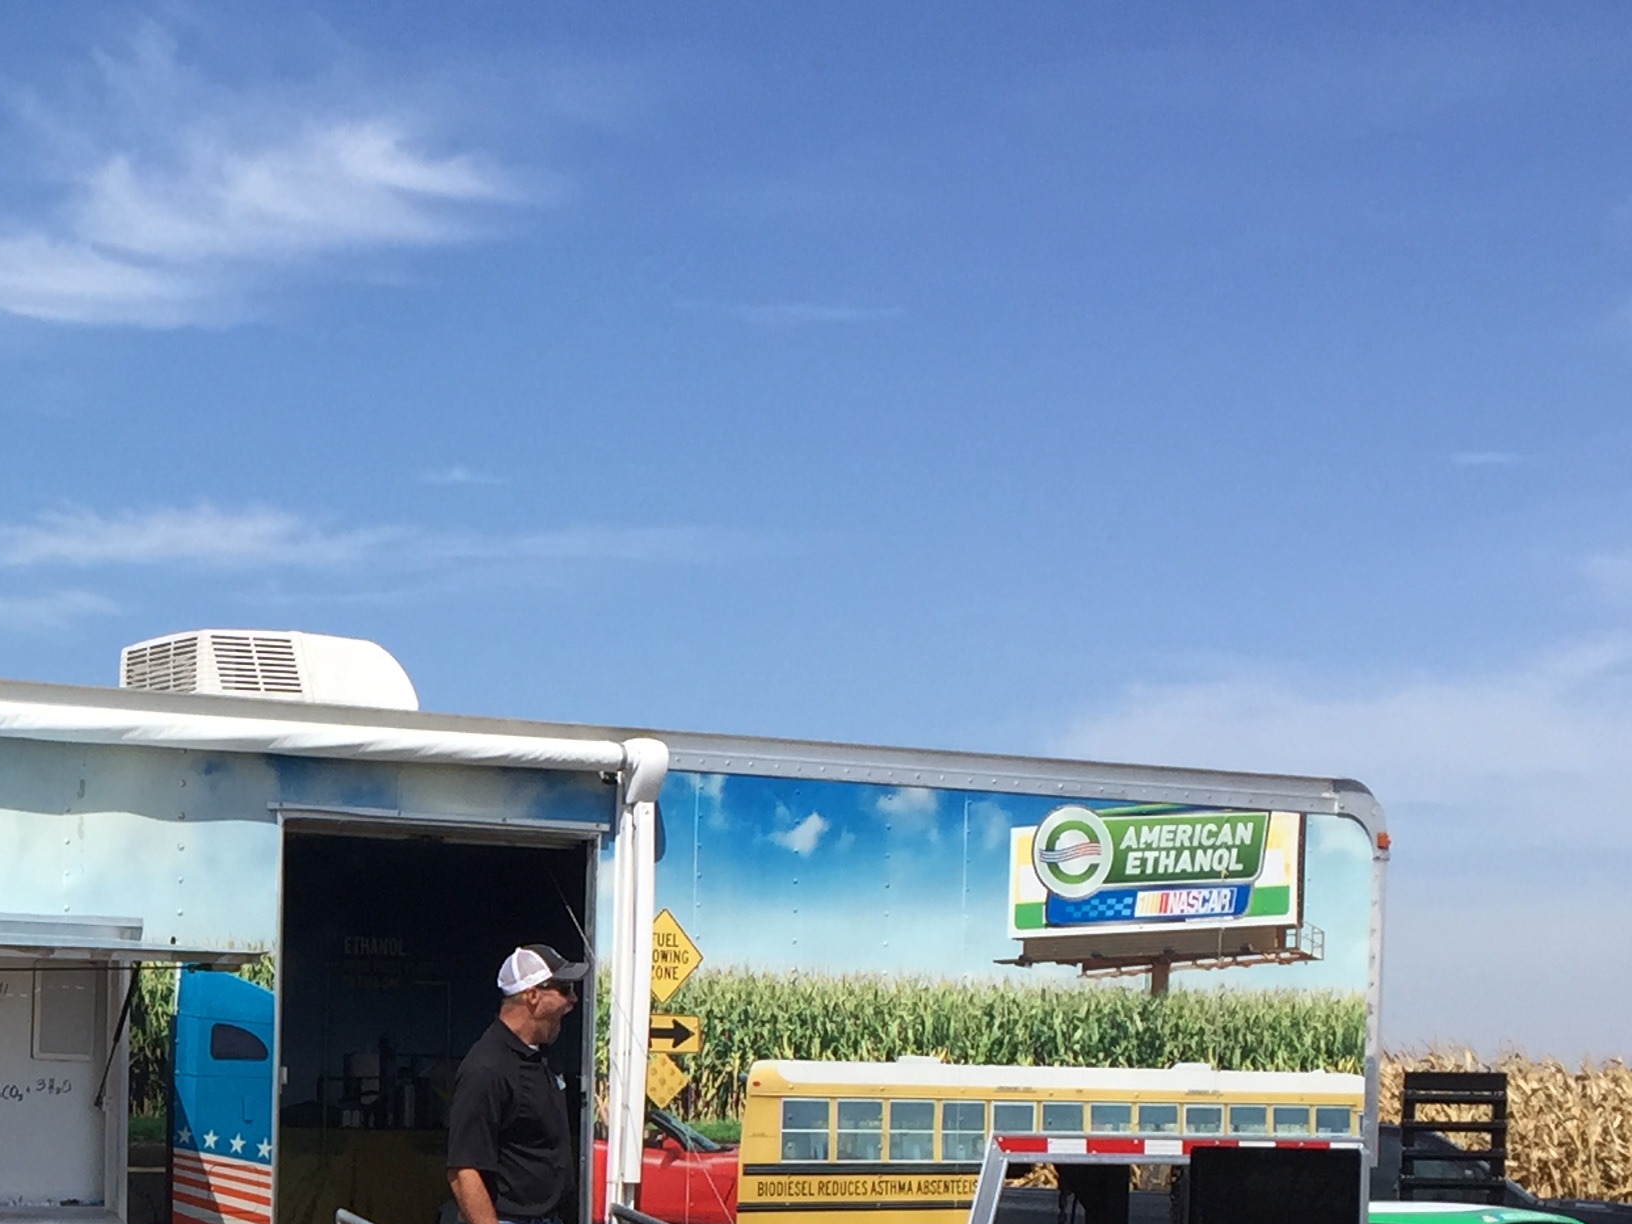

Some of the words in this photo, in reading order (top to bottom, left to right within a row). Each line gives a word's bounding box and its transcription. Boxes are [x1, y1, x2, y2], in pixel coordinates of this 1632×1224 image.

[1119, 822, 1254, 850] AMERICAN
[1125, 848, 1244, 875] ETHANOL
[1168, 889, 1232, 914] NASCAR
[757, 1180, 815, 1197] BIODIESEL
[817, 1180, 868, 1197] REDUCES
[870, 1179, 914, 1196] ASTHMA
[916, 1179, 979, 1196] ABSENTEEIS
